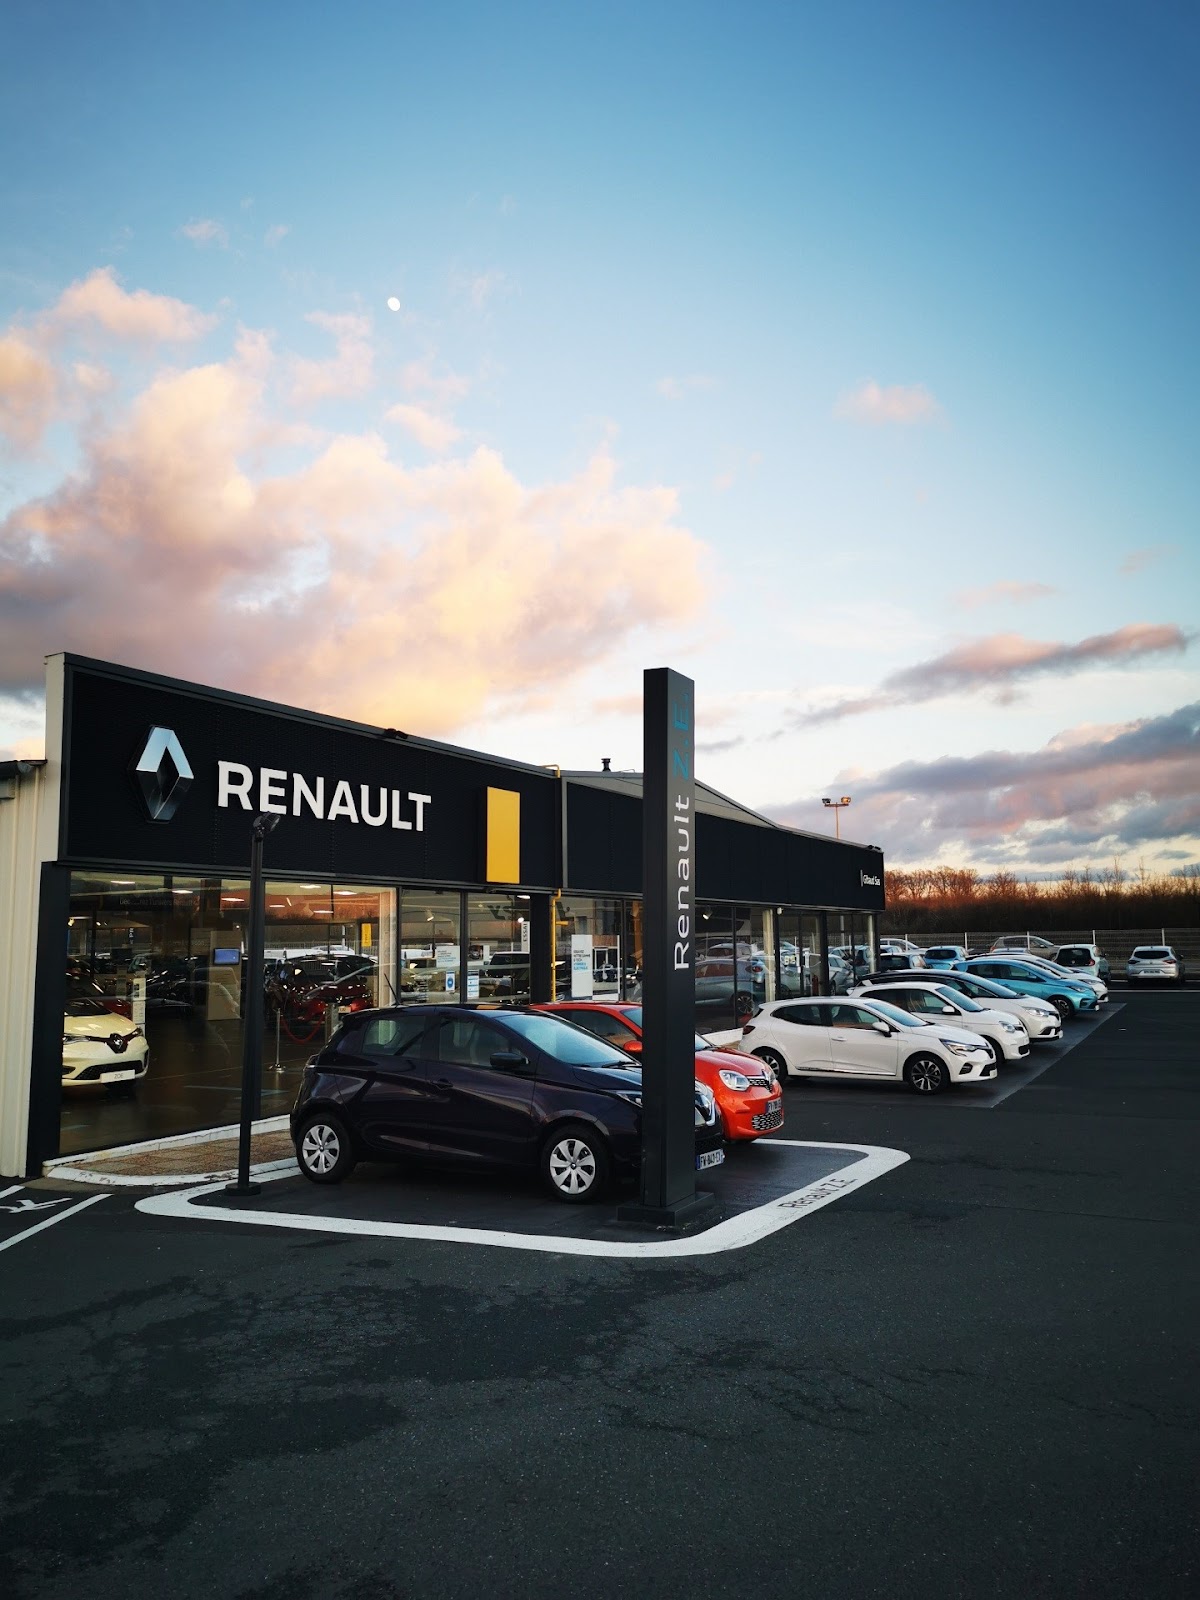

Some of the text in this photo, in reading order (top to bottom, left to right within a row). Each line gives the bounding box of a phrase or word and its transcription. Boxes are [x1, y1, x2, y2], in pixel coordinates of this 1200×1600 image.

[217, 760, 432, 832] RENAULT
[672, 692, 690, 971] Renault Z.E.
